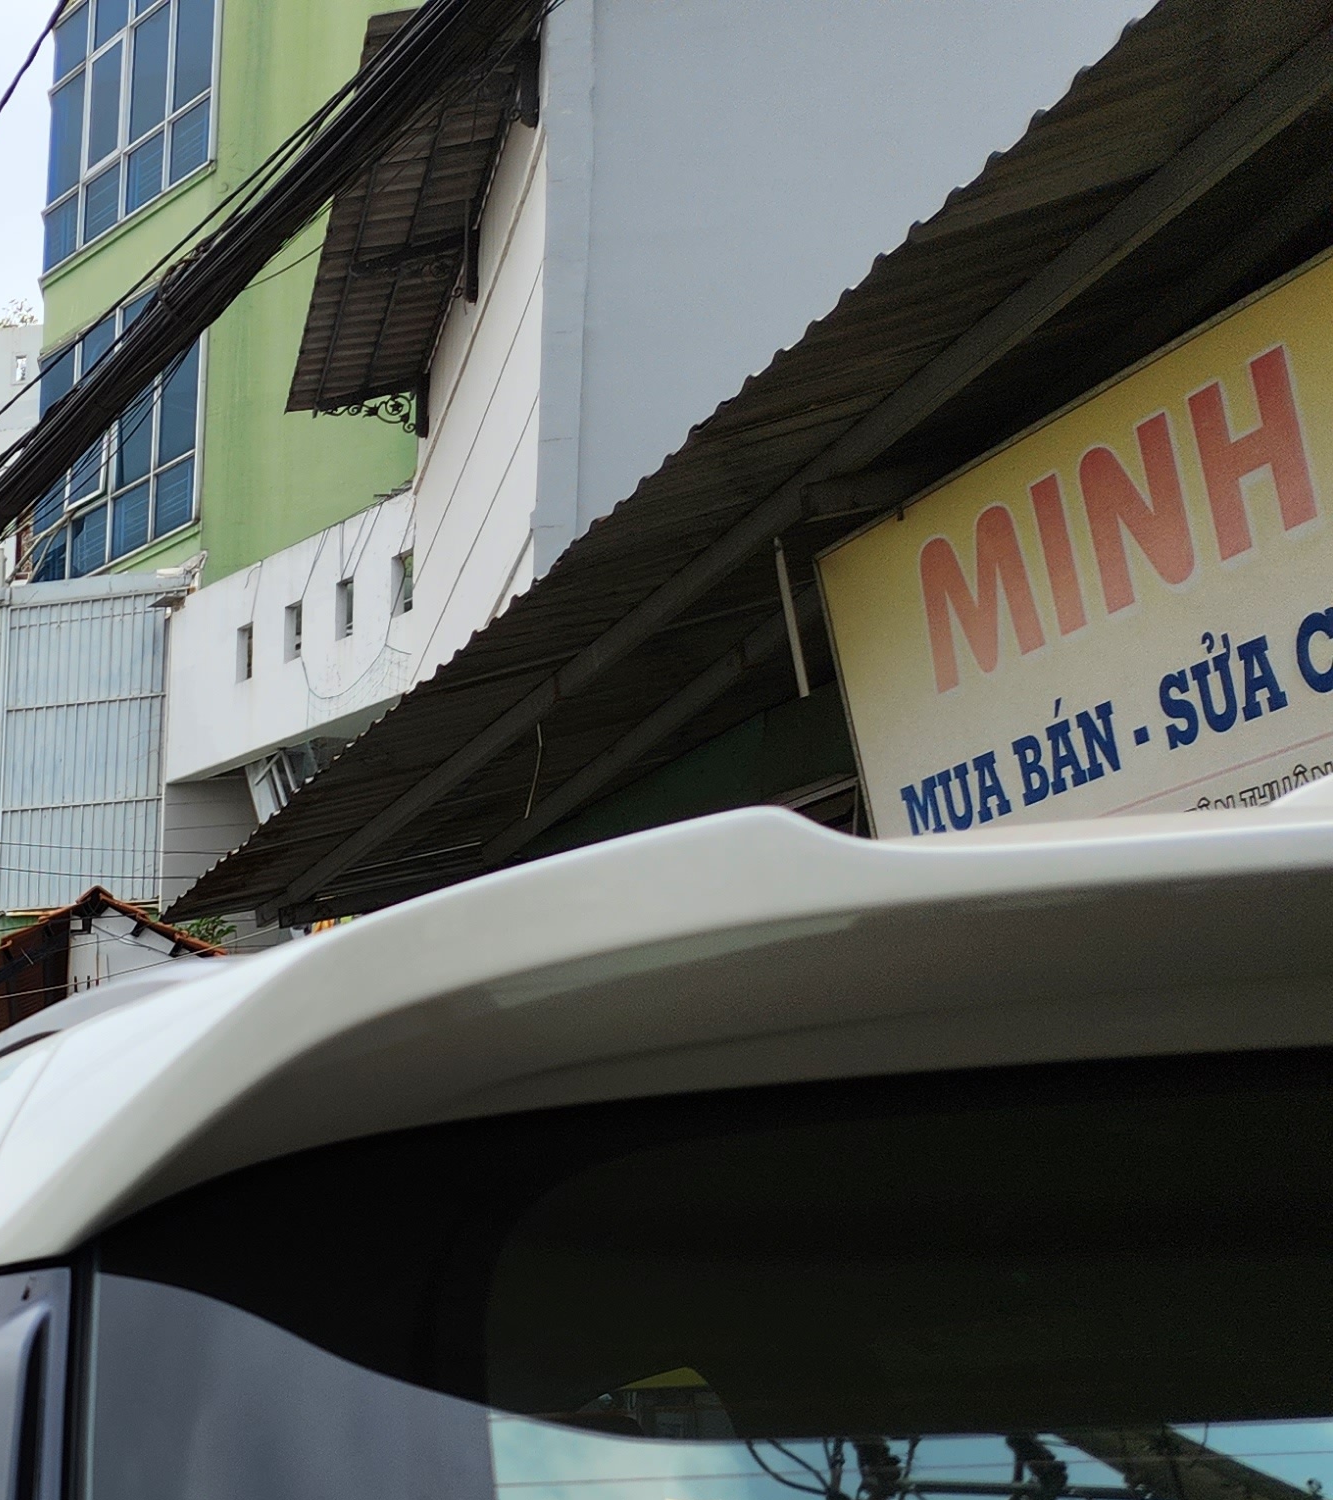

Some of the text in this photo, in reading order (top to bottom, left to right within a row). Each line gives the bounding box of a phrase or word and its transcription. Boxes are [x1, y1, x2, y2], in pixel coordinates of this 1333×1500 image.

[919, 344, 1318, 694] MINH
[900, 750, 1012, 836] MUA
[1012, 697, 1122, 807] BÁN
[1159, 631, 1289, 751] SỬA
